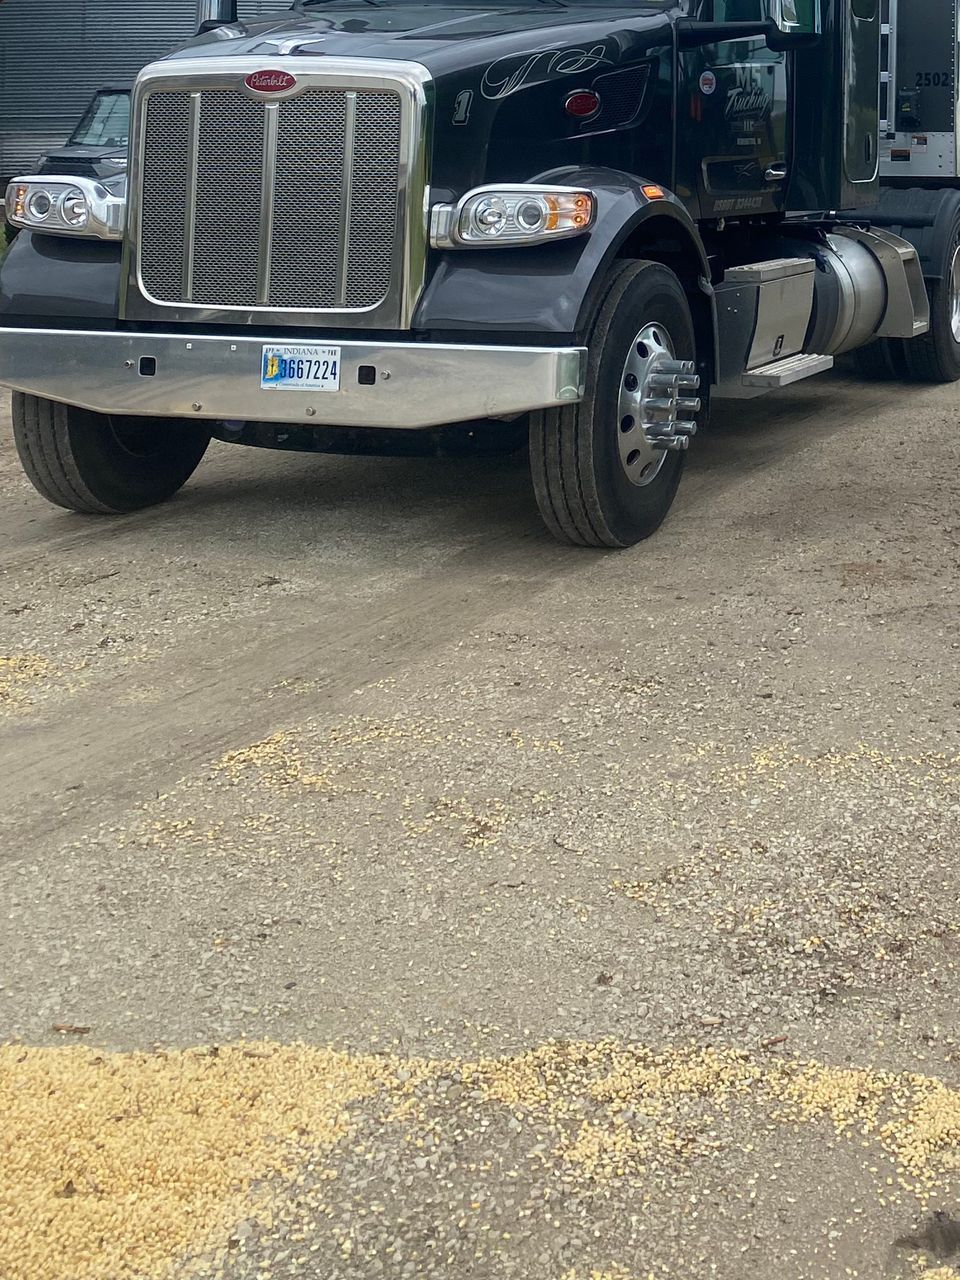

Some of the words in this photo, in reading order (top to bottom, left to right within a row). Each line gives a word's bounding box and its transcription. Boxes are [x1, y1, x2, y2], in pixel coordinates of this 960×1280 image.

[251, 74, 292, 87] Peterbilt
[915, 72, 949, 87] 2502
[452, 89, 474, 126] 1
[726, 87, 772, 119] Trucking
[284, 347, 319, 356] INDIANA
[280, 359, 337, 380] 3667224
